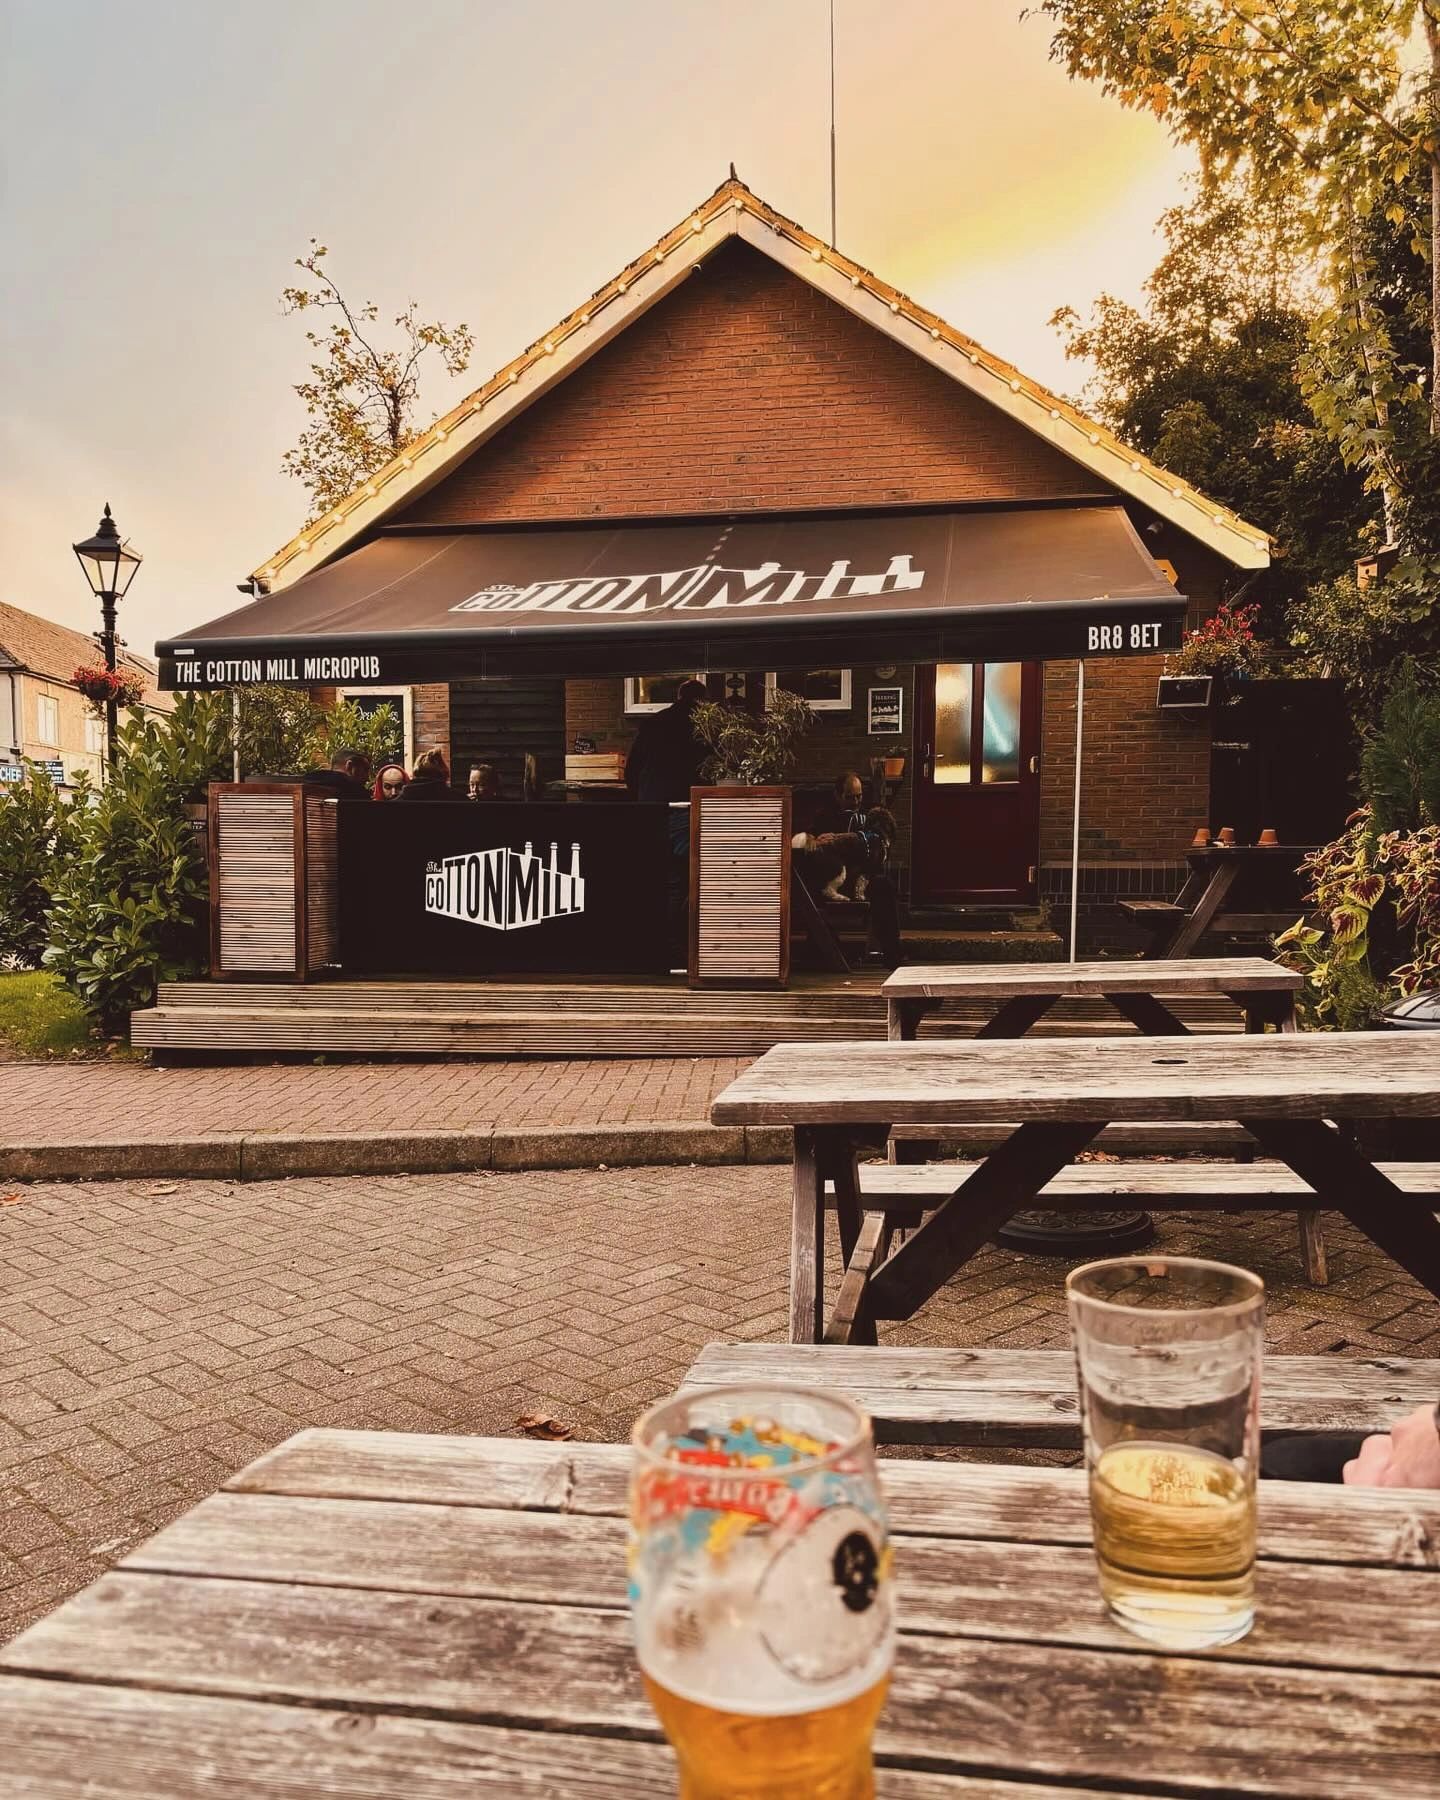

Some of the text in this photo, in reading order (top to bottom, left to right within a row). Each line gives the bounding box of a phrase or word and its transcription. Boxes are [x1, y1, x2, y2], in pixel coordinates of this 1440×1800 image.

[456, 568, 911, 611] COTTON MILL
[1088, 623, 1162, 650] BR8 8ET
[176, 656, 381, 682] THE COTTON MILL MICROPUB
[426, 861, 443, 873] The
[426, 850, 582, 925] COTTON MILL
